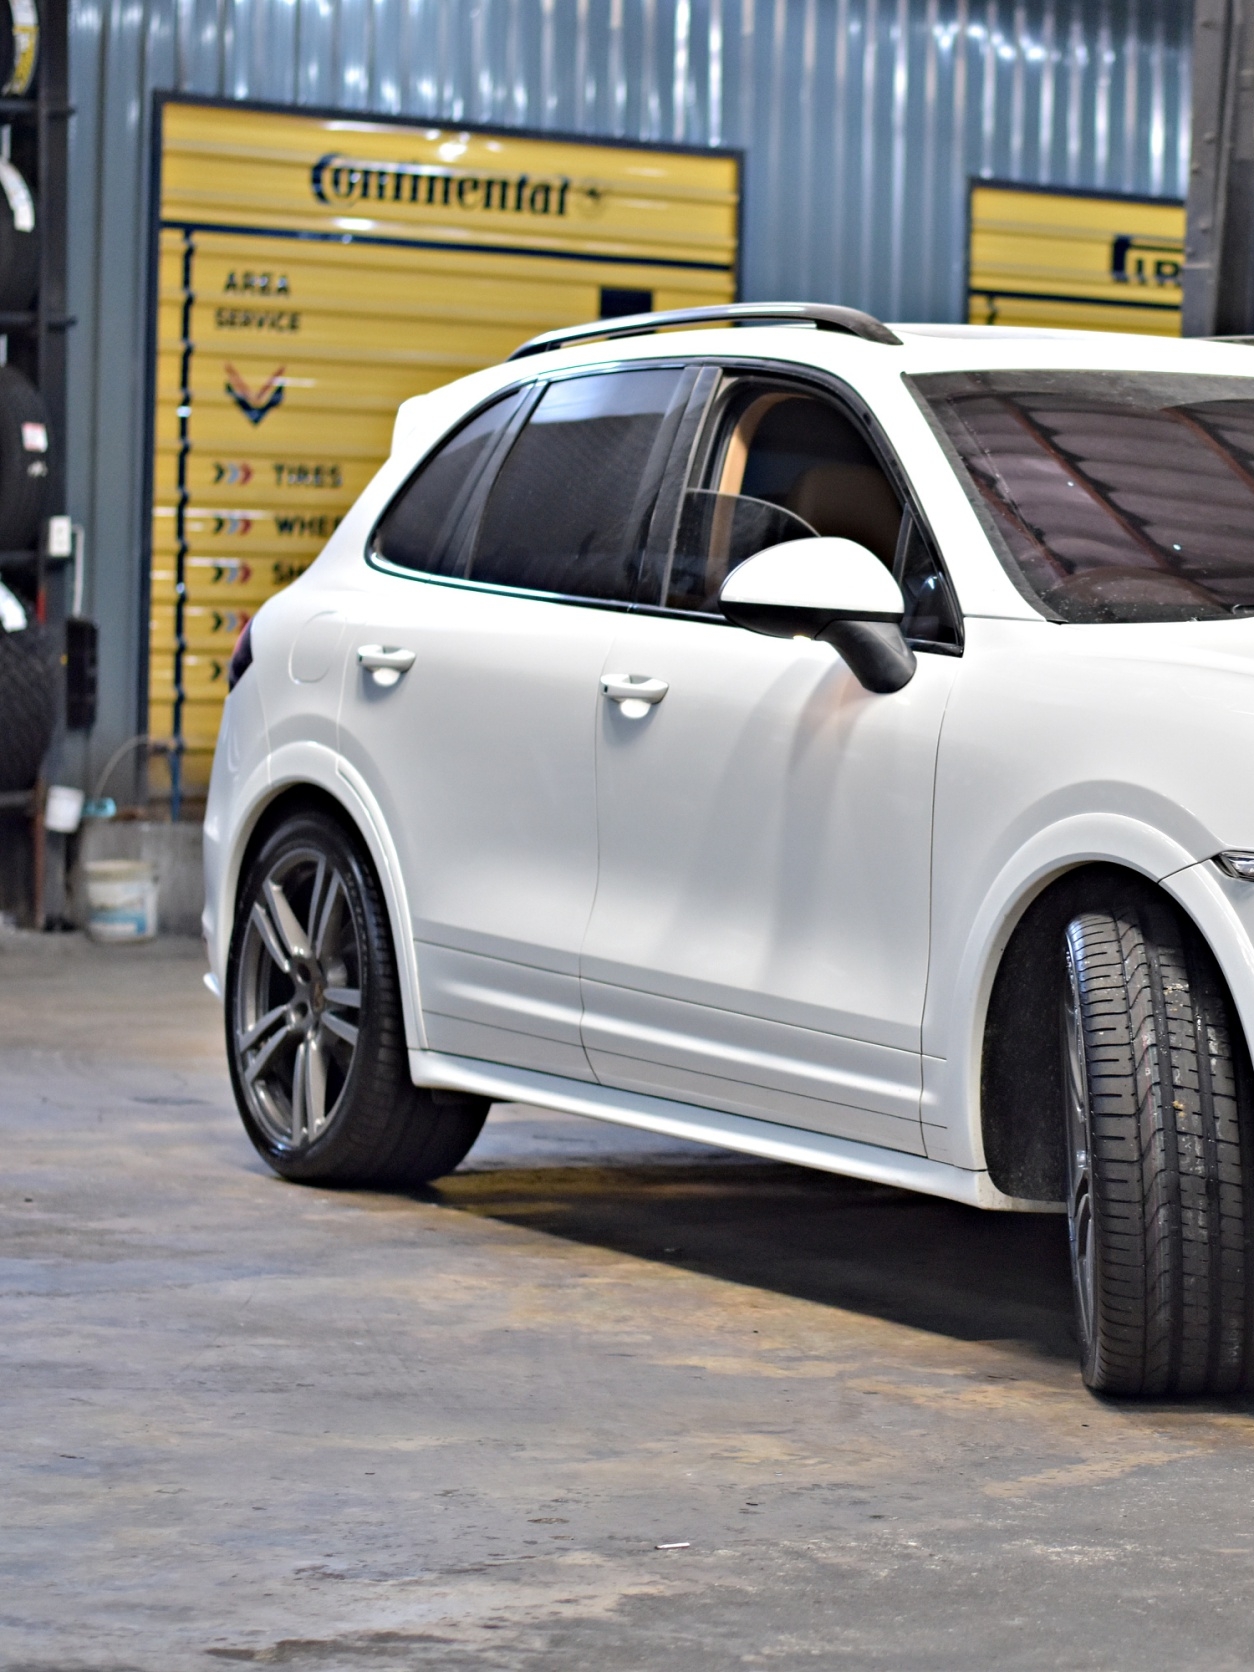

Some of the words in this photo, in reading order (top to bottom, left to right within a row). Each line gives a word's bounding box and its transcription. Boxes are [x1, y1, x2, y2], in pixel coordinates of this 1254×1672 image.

[309, 152, 574, 217] Continental
[223, 269, 290, 297] AREA
[214, 306, 302, 333] SERVICE
[273, 462, 344, 488] TIRES
